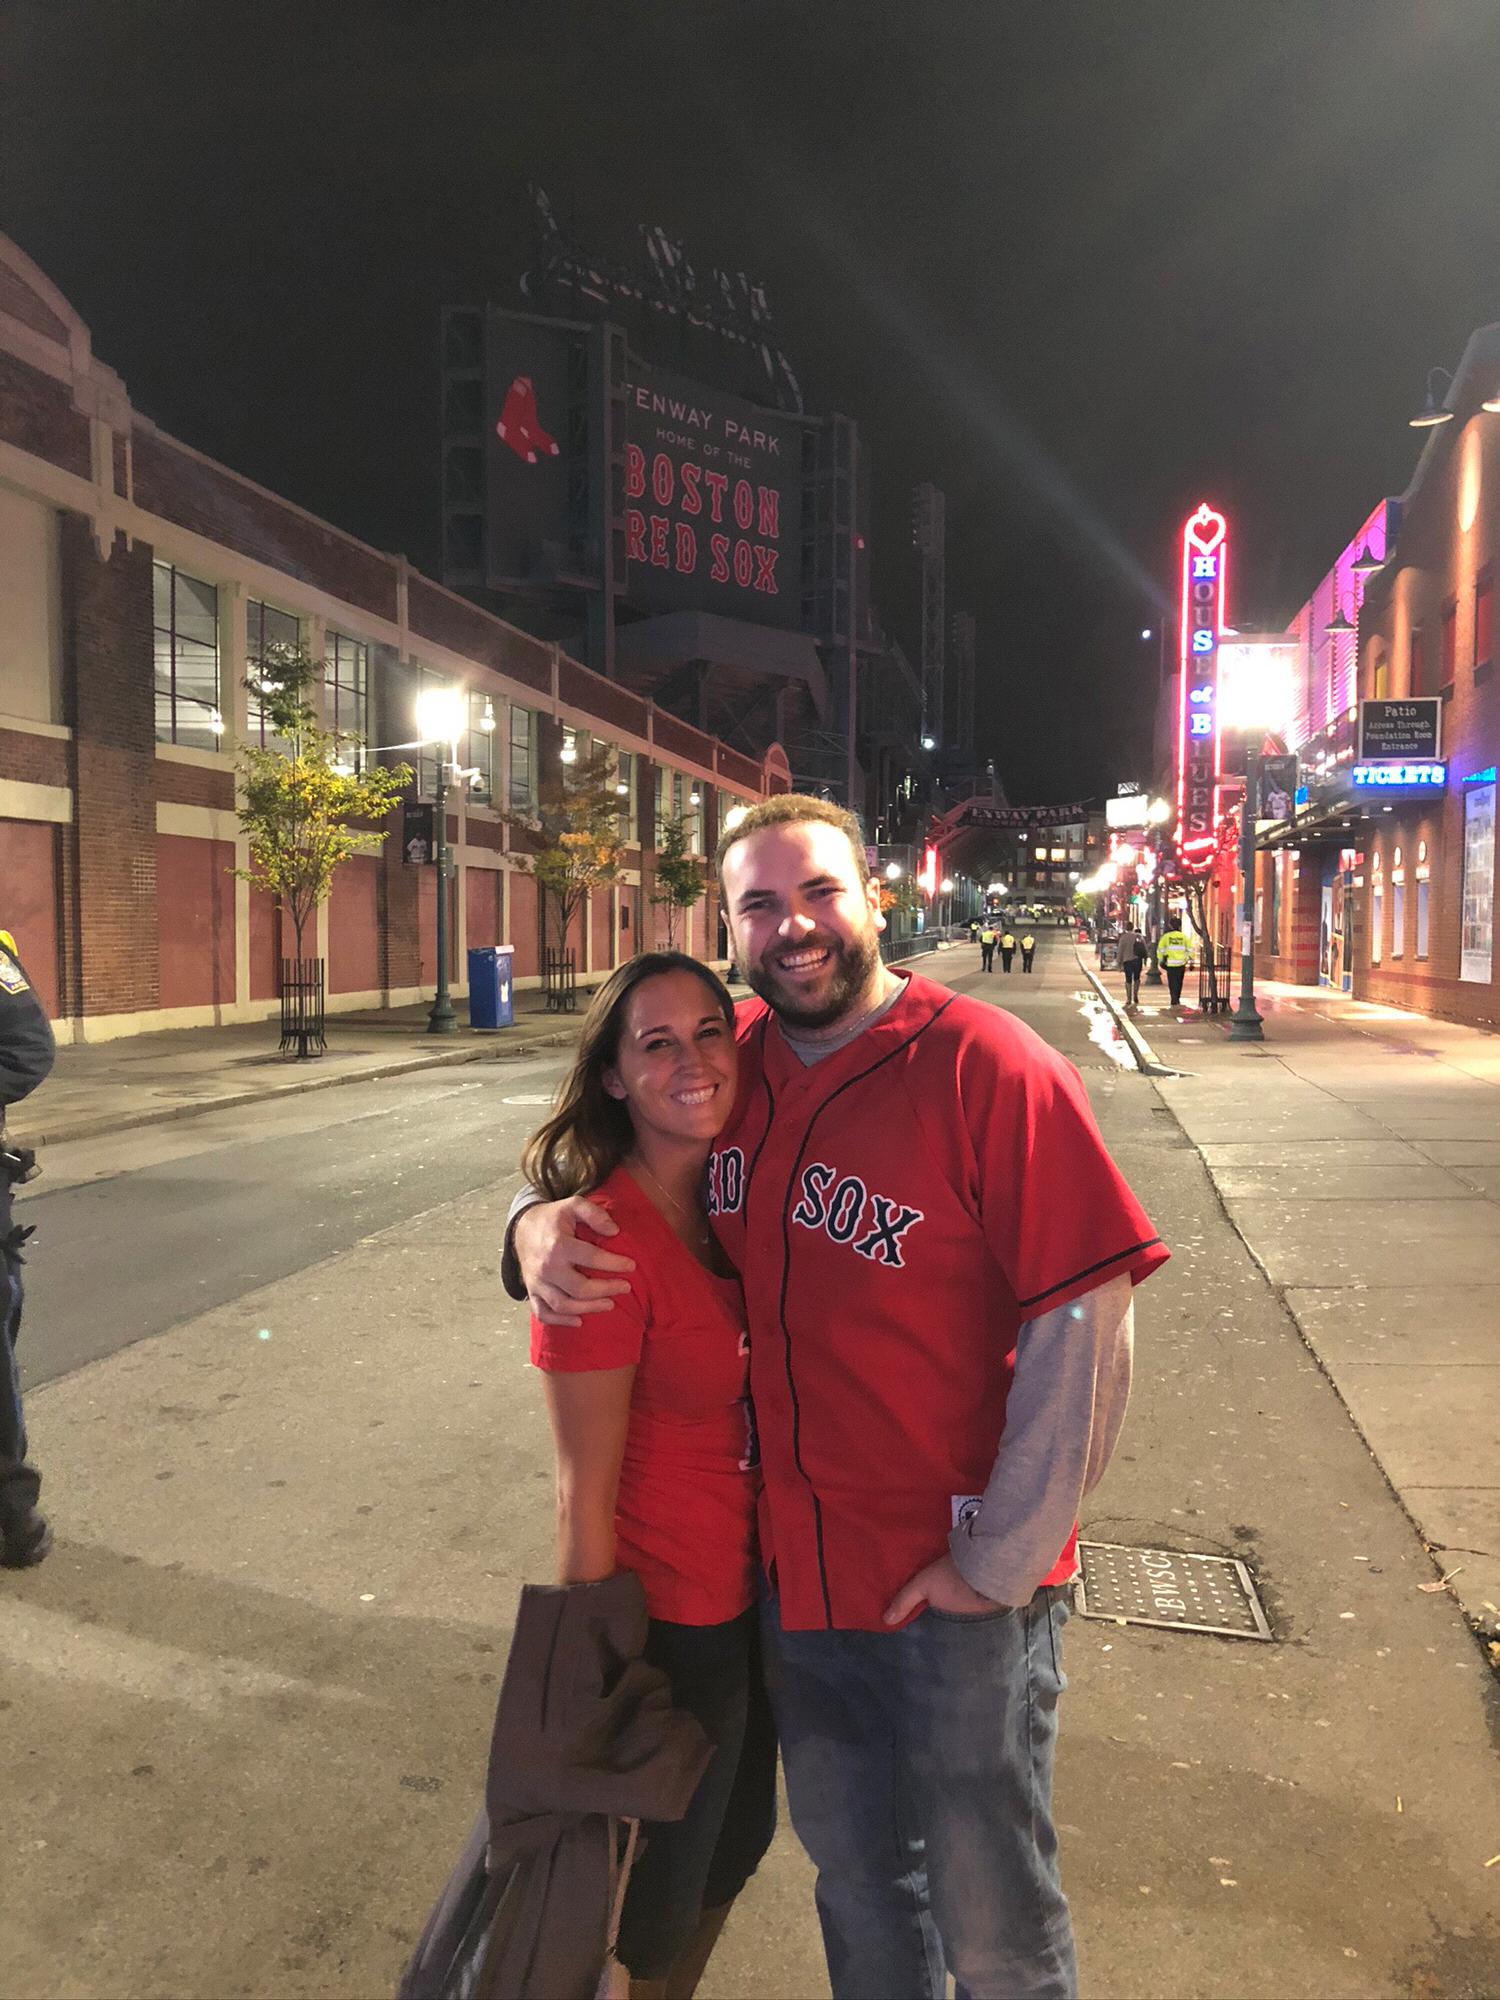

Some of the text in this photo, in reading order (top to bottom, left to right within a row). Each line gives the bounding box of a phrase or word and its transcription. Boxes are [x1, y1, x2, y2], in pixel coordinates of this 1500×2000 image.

[655, 427, 752, 469] HOME OF THE
[724, 419, 780, 456] PARK
[624, 442, 780, 539] BOSTON
[624, 508, 780, 595] RED SOX
[1191, 555, 1217, 676] HOUSE
[1368, 719, 1431, 733] Access Through
[1384, 705, 1417, 717] Patio
[1364, 730, 1433, 741] Foundation Room
[1380, 741, 1419, 751] Entrance
[1188, 713, 1213, 833] BLUES
[1352, 765, 1446, 785] TICKETS
[970, 808, 1030, 821] ENWAY
[1035, 804, 1085, 820] PARK
[791, 1161, 925, 1269] SOX
[1140, 1555, 1186, 1611] BWSC
